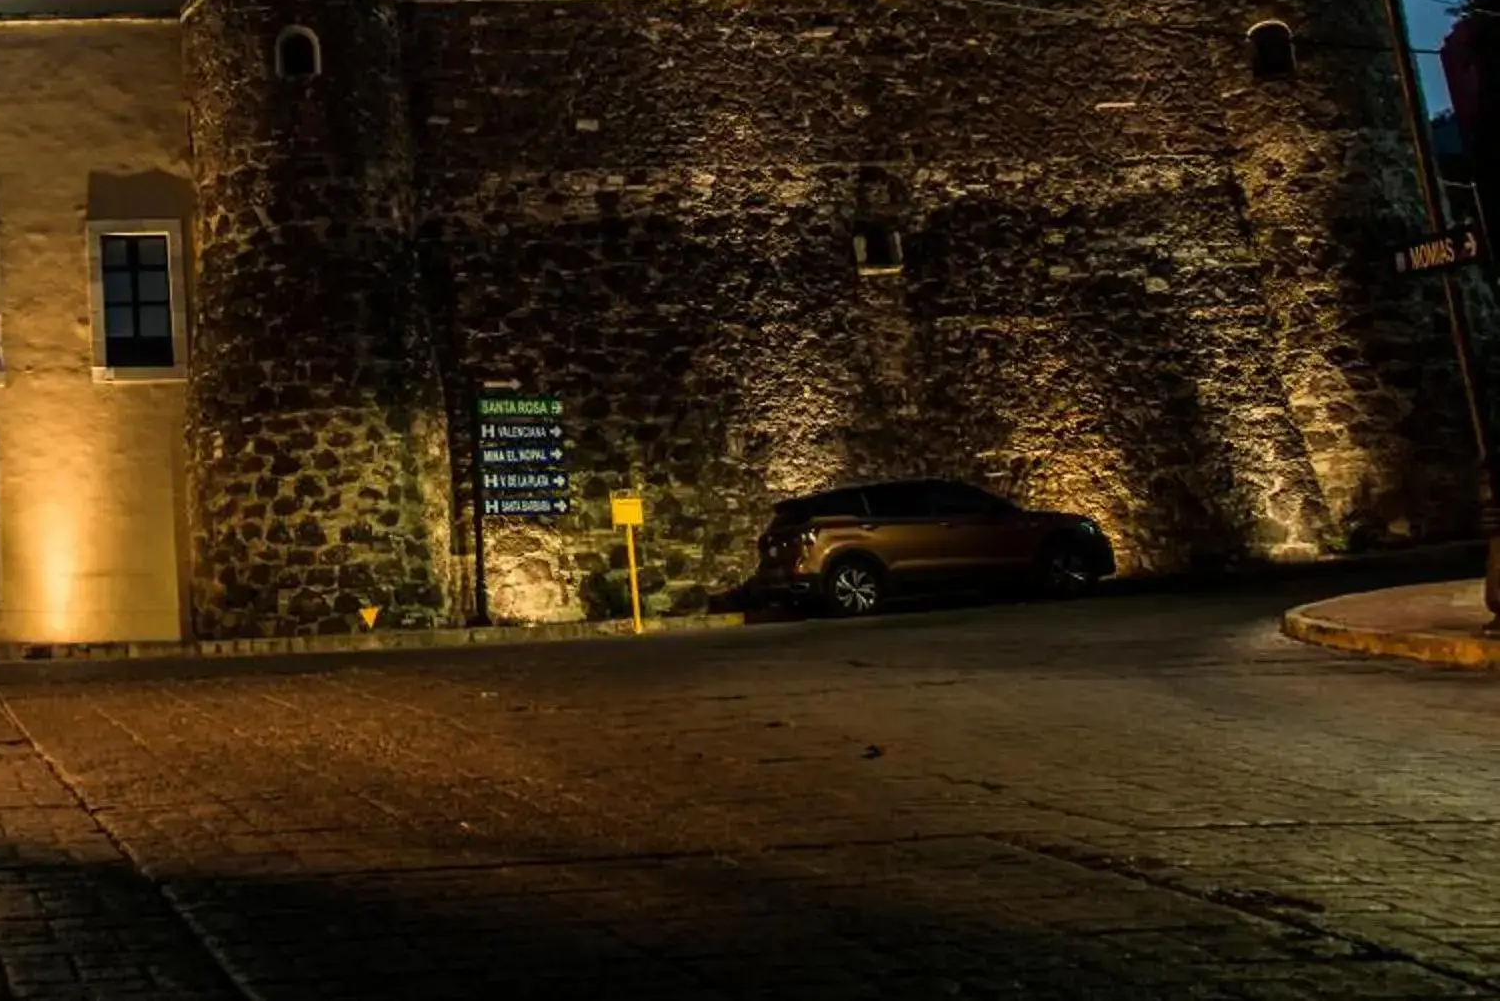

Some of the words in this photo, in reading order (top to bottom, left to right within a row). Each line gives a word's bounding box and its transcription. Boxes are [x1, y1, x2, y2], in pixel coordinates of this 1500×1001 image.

[482, 400, 517, 414] SANTA
[518, 400, 547, 414] ROSA
[498, 426, 547, 437] VALENCIANA
